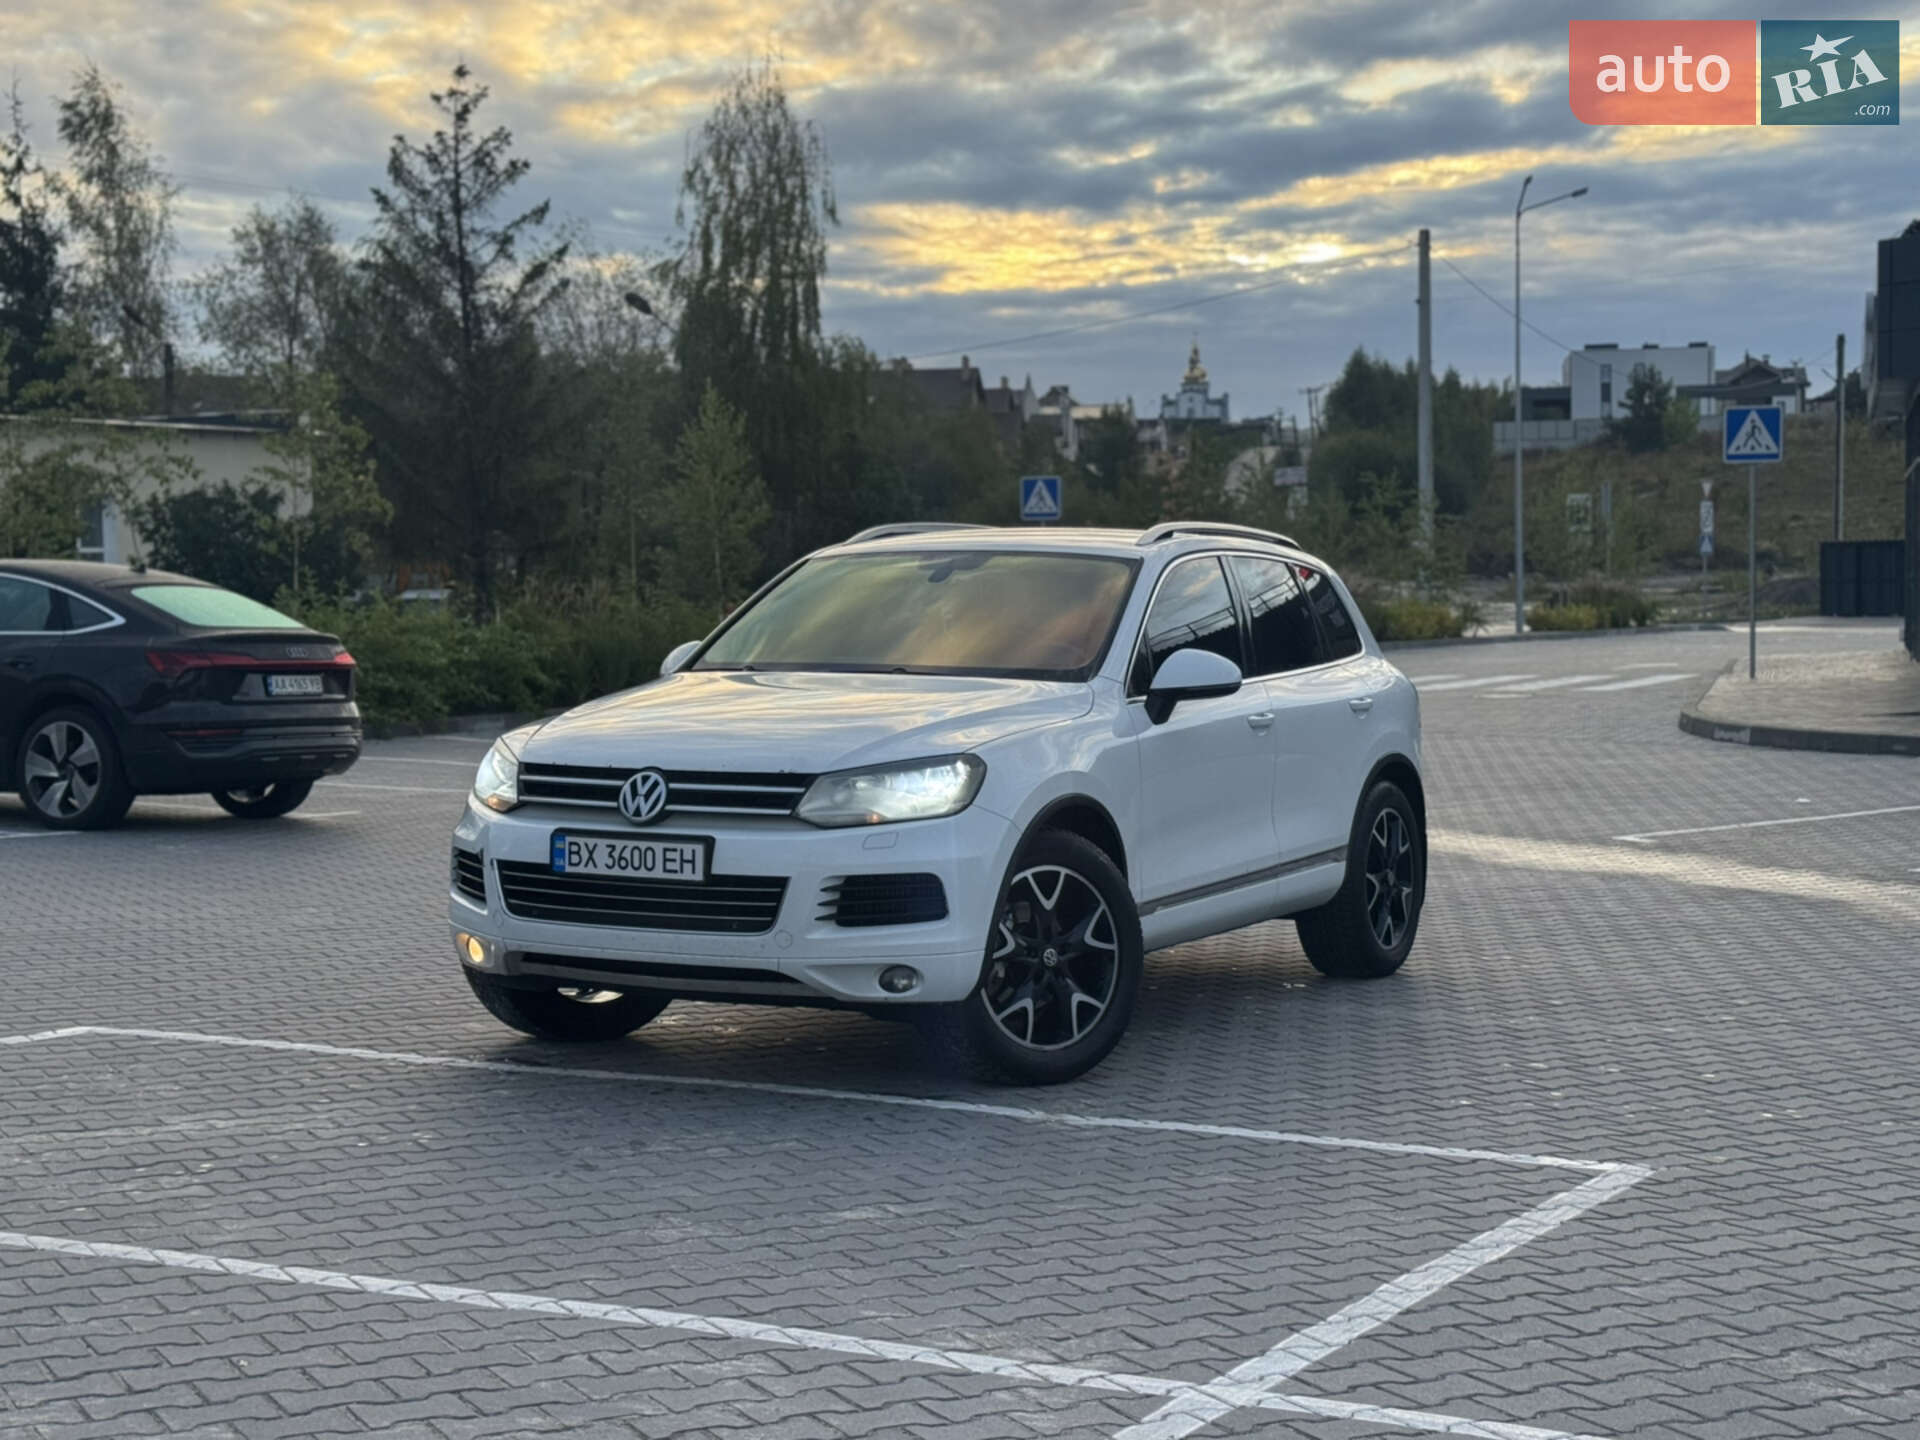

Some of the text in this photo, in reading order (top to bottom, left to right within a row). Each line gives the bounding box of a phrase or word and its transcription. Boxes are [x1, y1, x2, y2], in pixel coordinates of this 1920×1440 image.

[568, 841, 696, 875] BX 3600 EH
